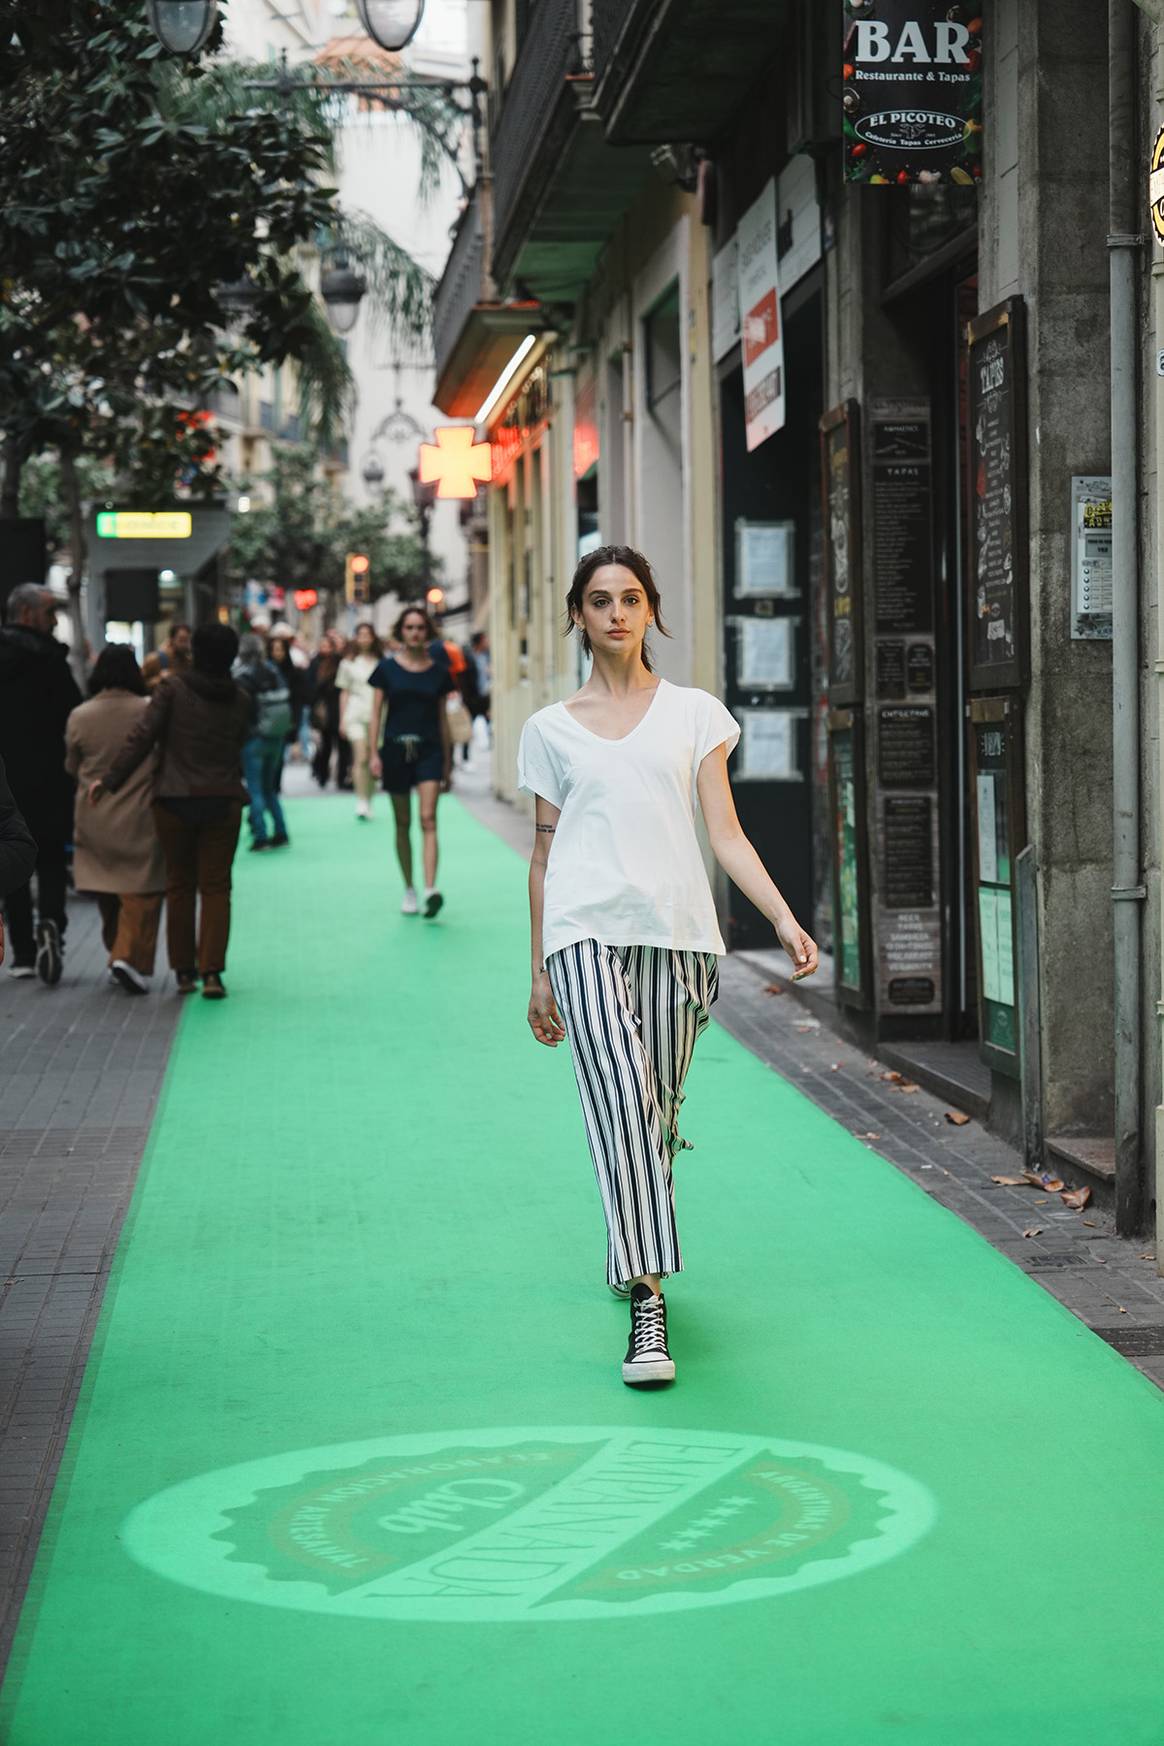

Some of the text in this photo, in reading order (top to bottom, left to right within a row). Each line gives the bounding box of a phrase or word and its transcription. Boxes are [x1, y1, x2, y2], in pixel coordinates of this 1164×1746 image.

[855, 20, 970, 63] BAR
[856, 70, 970, 83] Restaurante & Tapas
[870, 112, 956, 128] EL PICOTEO
[361, 1440, 746, 1598] EMPANADA
[374, 1477, 525, 1535] Club
[611, 1470, 836, 1581] ARGENTINAS DE VERDAD
[289, 1506, 372, 1569] ARTESANAL
